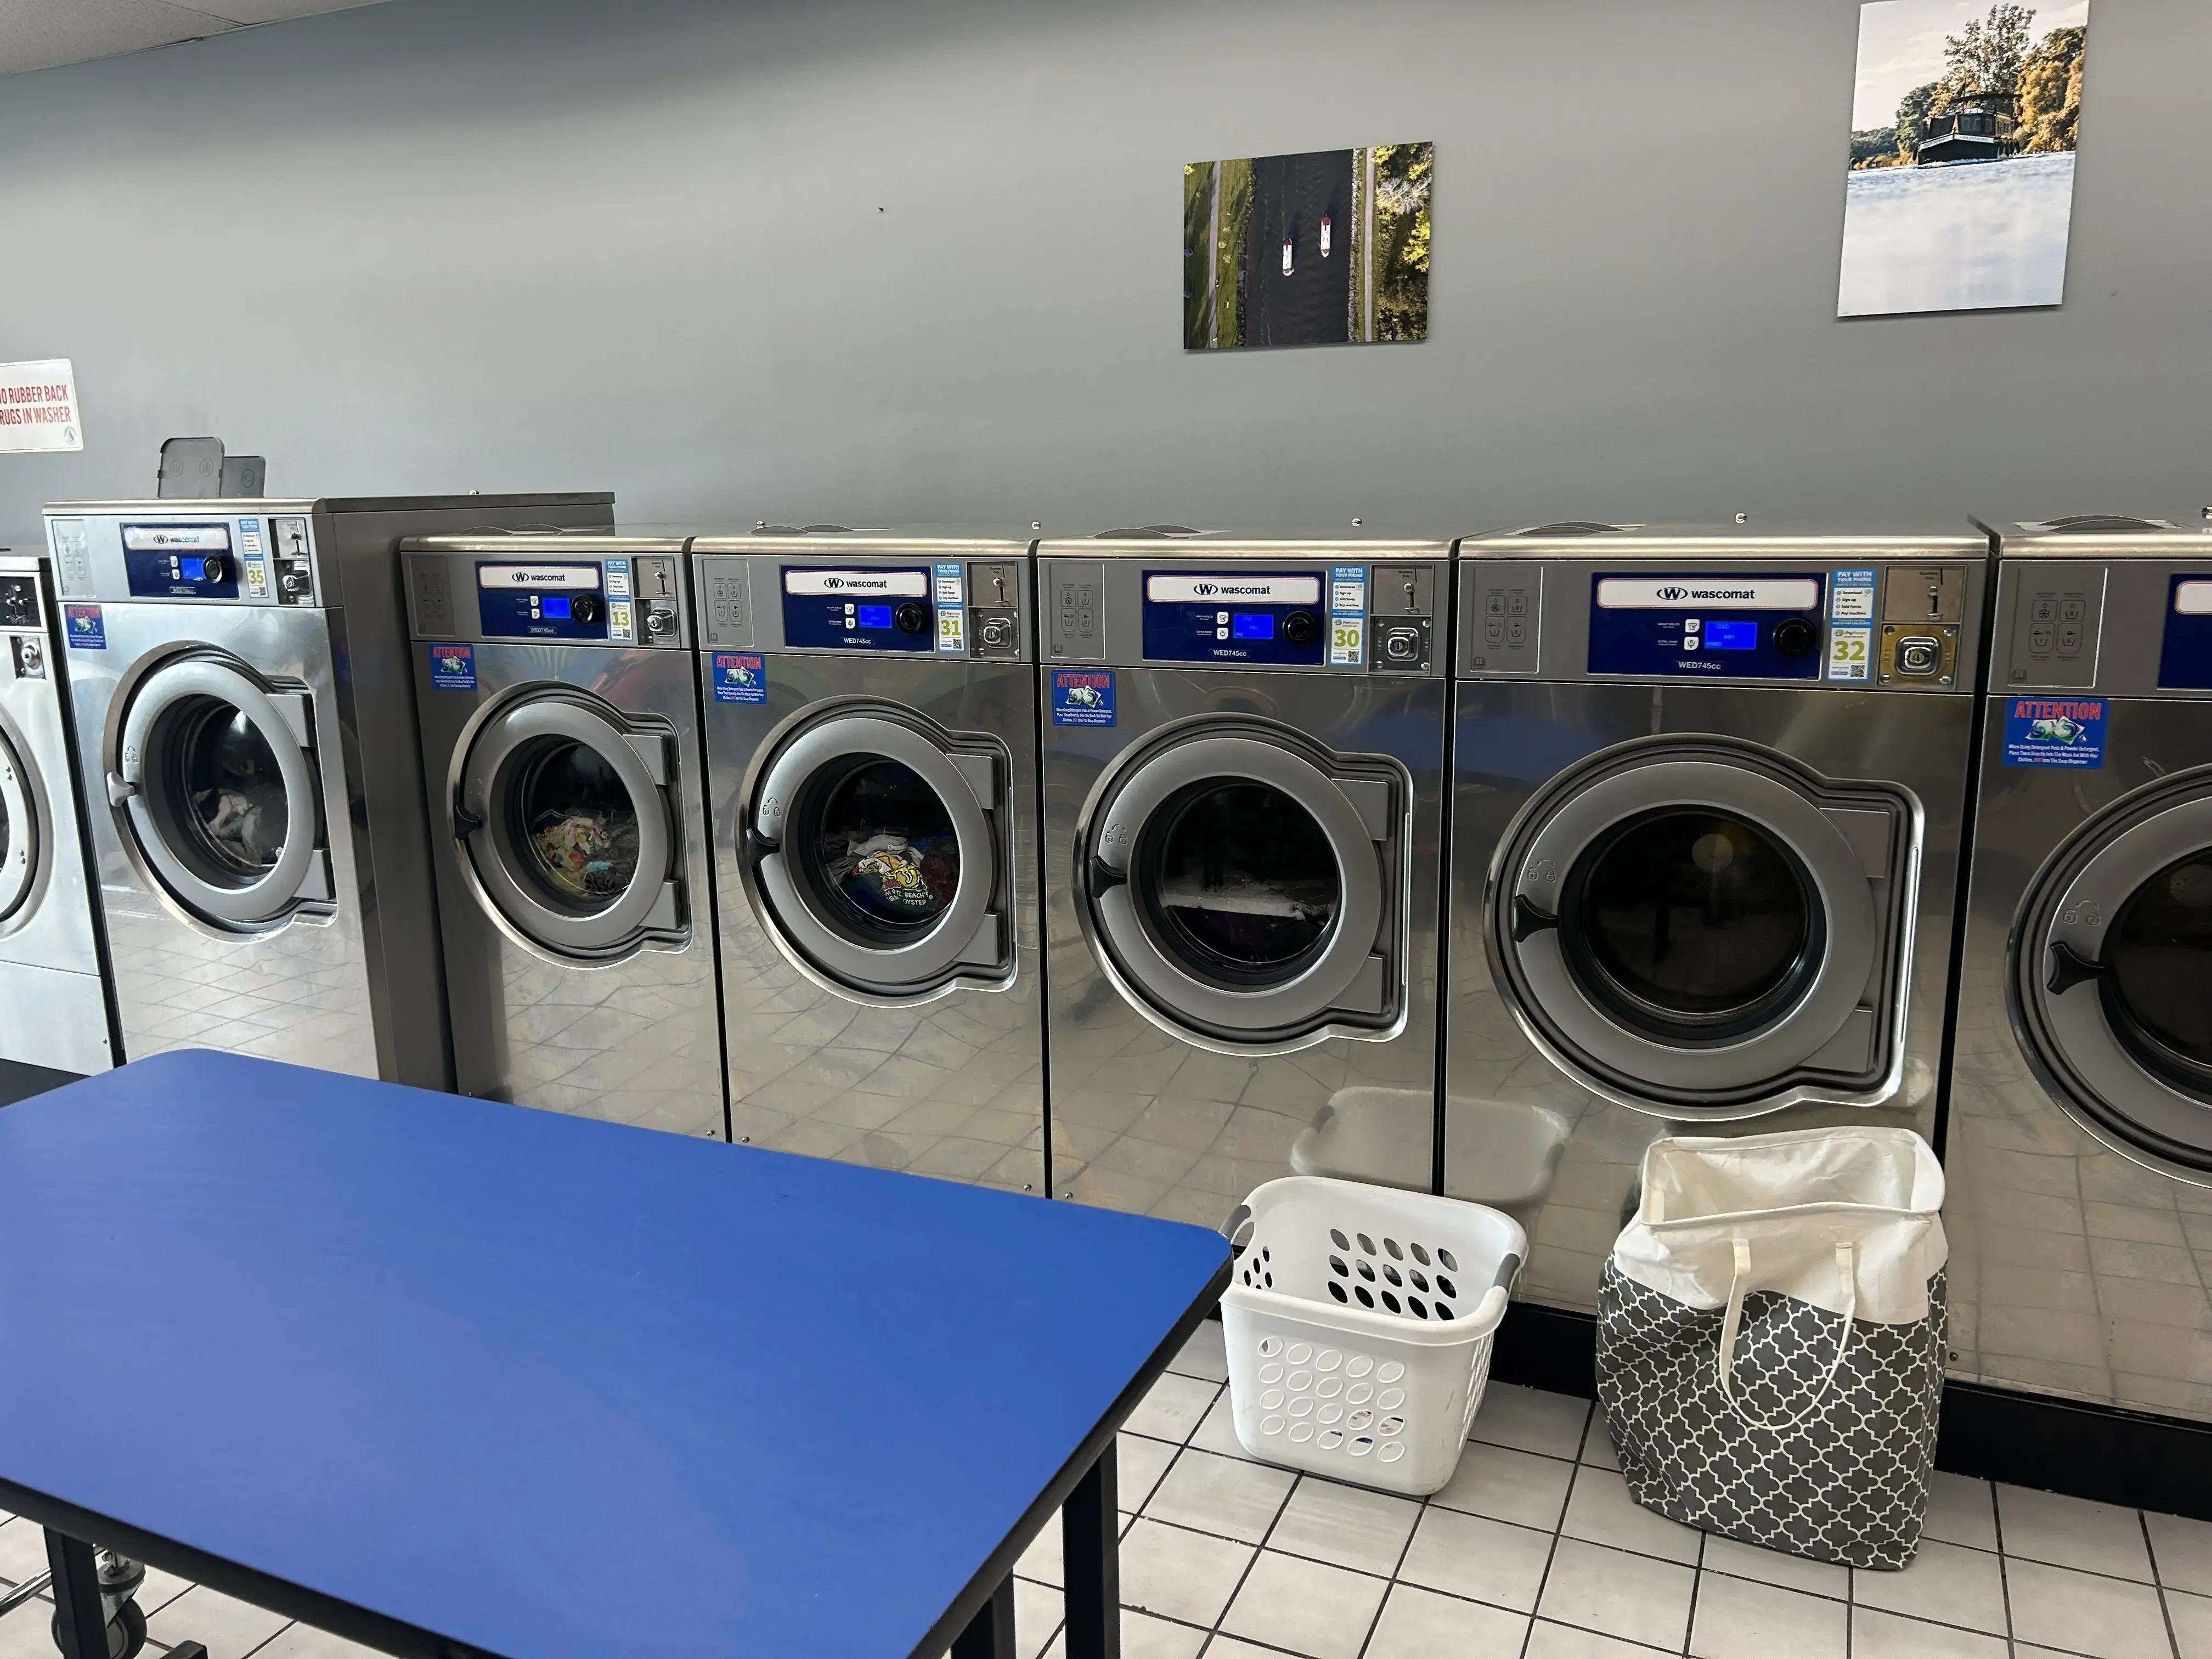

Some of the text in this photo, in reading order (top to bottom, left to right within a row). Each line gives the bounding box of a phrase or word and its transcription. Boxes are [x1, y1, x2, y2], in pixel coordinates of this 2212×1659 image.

[8, 386, 43, 404] RUBBER
[44, 385, 69, 402] BACK
[0, 406, 72, 425] RUGS IN WASHER
[249, 570, 264, 584] 35
[1221, 585, 1271, 594] wascomat
[1691, 589, 1755, 599] wascomat
[612, 612, 629, 626] 13
[940, 620, 961, 636] 31
[1334, 629, 1359, 647] 30
[433, 646, 471, 659] ATTENTION
[1832, 641, 1865, 661] 32
[716, 655, 761, 669] ATTENTION
[1678, 661, 1722, 669] WED745cc
[1057, 674, 1110, 689] ATTENTION
[2014, 701, 2102, 720] ATTENTION
